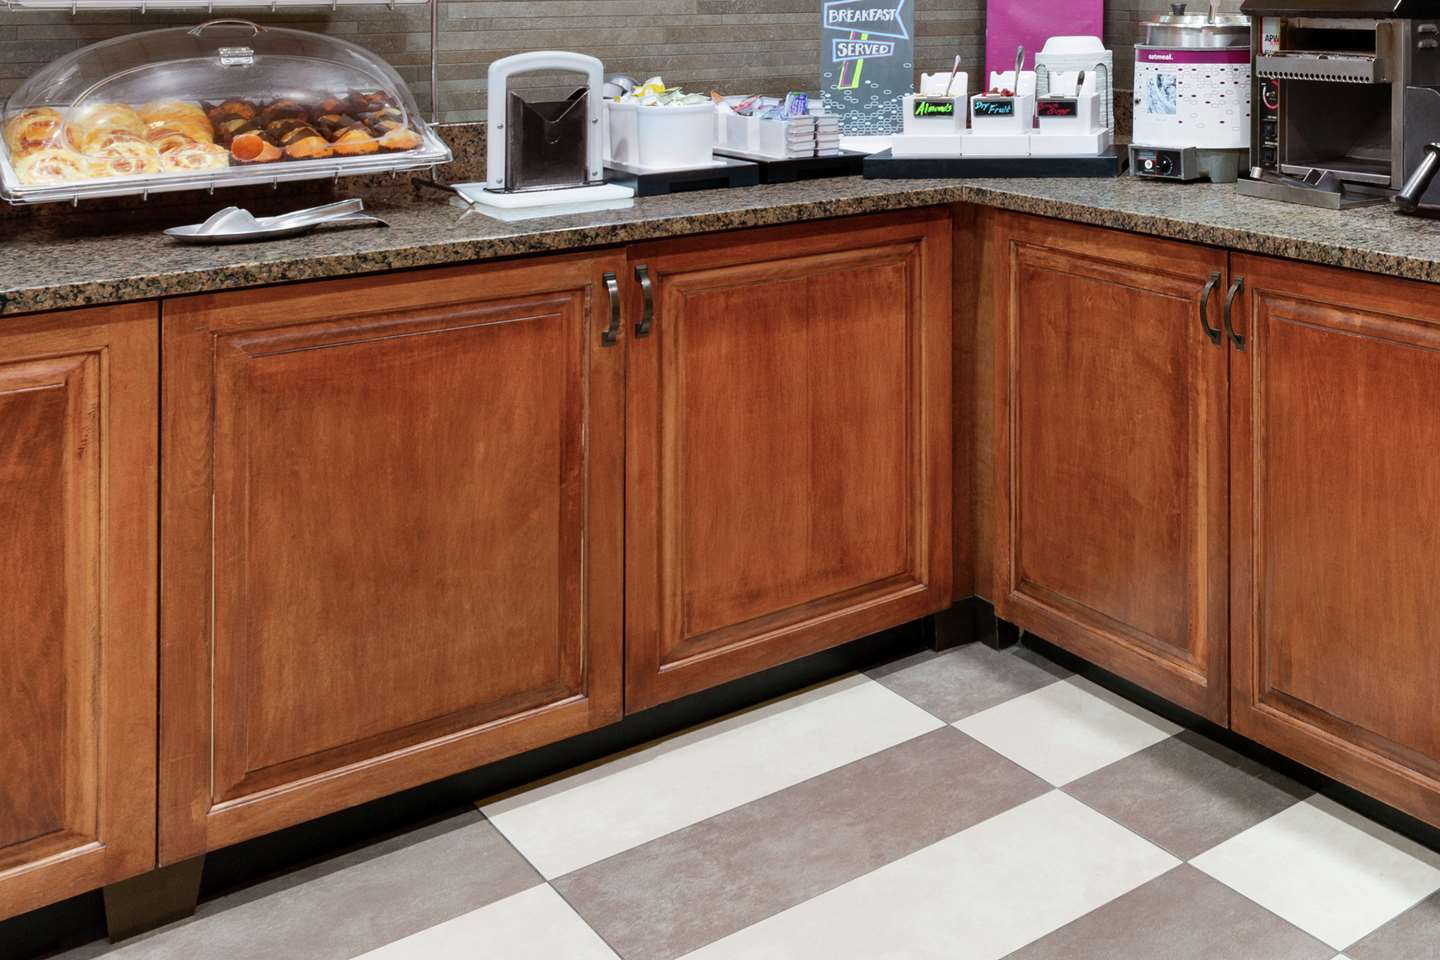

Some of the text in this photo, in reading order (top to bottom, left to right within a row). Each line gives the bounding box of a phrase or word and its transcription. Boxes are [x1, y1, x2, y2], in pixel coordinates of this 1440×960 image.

[829, 8, 897, 23] BREAKFAST
[837, 43, 889, 56] SERVED
[915, 101, 953, 115] Almonds
